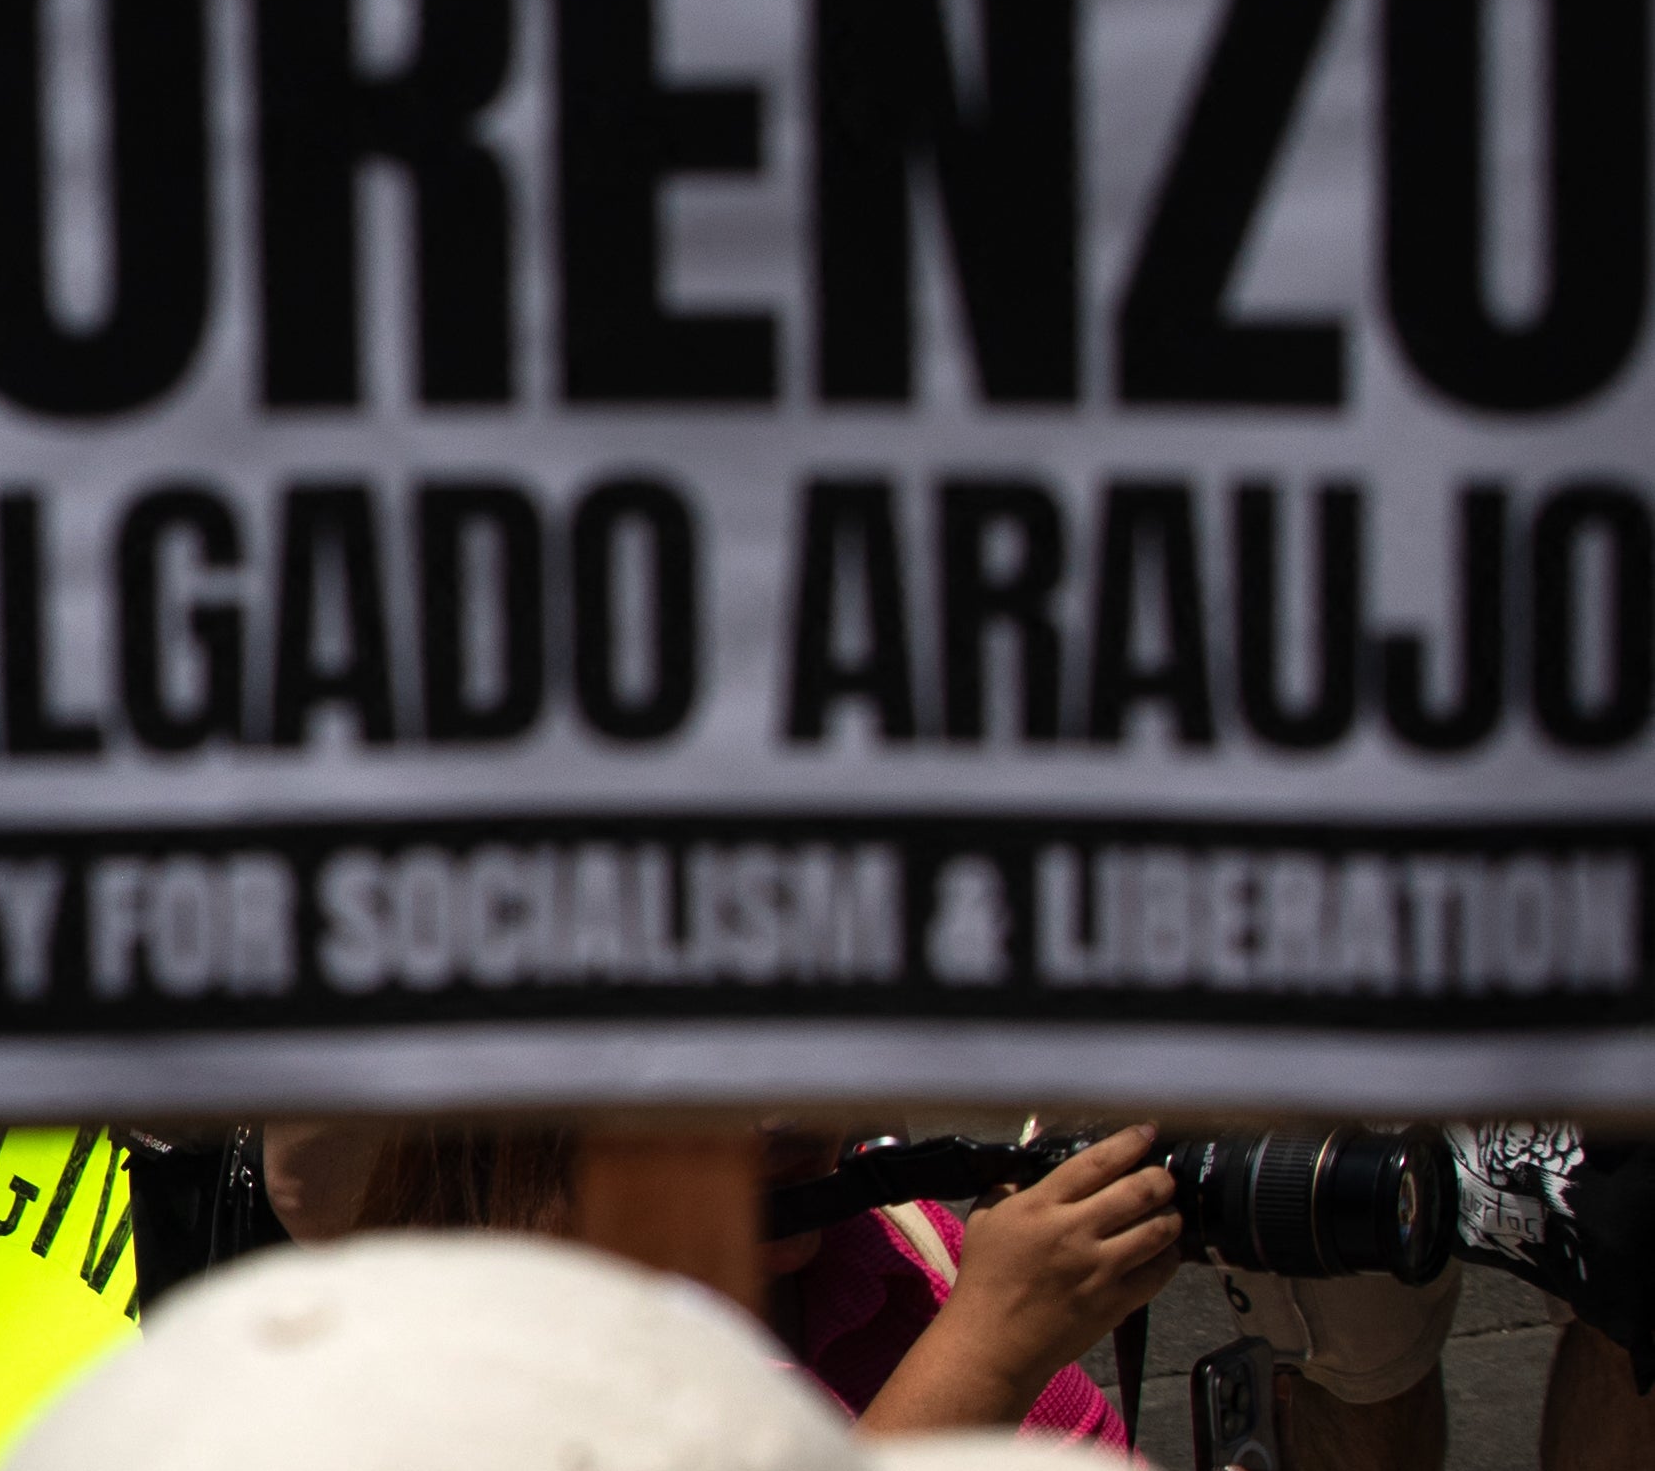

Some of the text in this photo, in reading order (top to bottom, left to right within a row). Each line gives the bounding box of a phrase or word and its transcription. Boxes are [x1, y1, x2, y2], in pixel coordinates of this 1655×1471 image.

[781, 470, 1653, 755] ARAUJO
[90, 856, 293, 990] FOR
[320, 847, 897, 987] SOCIALISM
[931, 862, 1003, 980] &
[1039, 847, 1635, 988] LIBERATION
